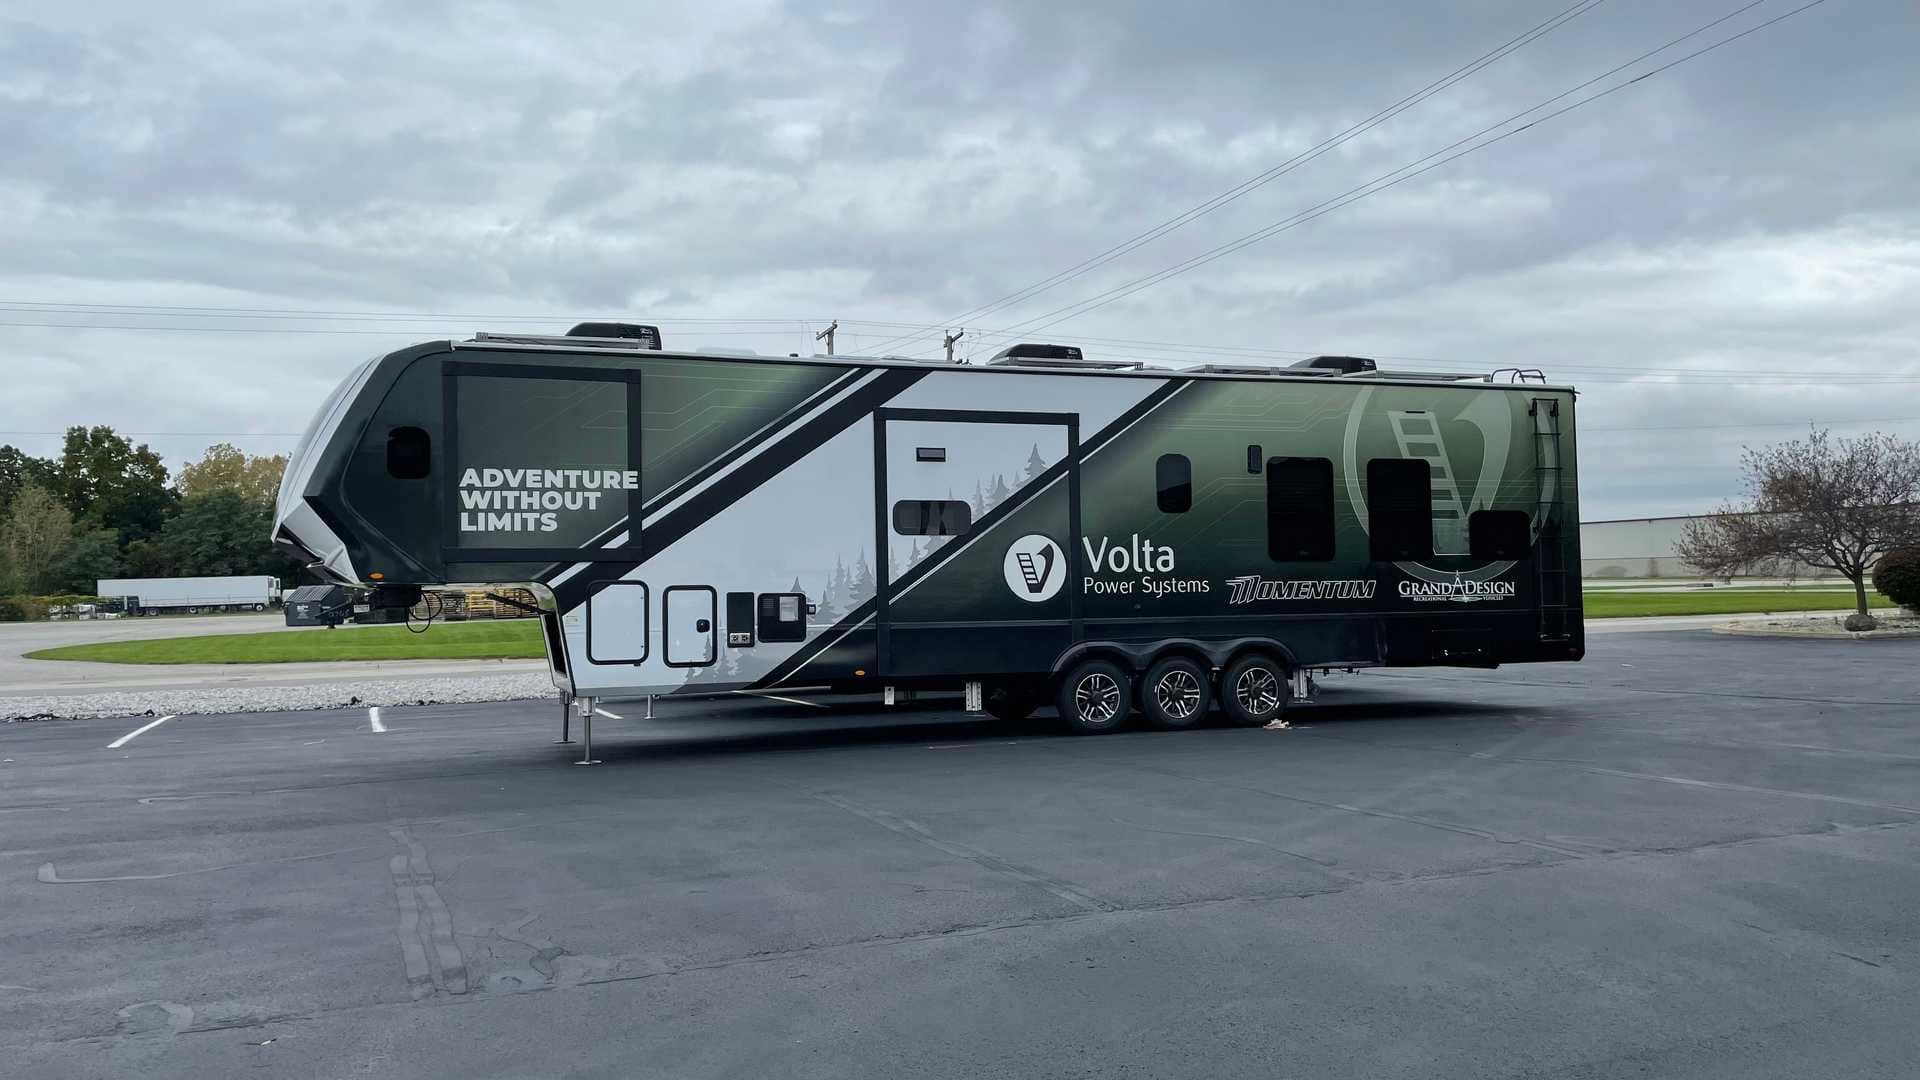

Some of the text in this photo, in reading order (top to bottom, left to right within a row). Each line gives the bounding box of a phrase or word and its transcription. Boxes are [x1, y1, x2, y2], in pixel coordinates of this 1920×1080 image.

[459, 468, 639, 488] ADVENTURE
[460, 490, 601, 510] WITHOUT
[460, 512, 558, 531] LIMITS
[1082, 533, 1175, 573] Volta
[1083, 577, 1210, 598] Power Systems
[1225, 575, 1376, 604] MOMENTUM
[1465, 580, 1515, 594] DESIGN
